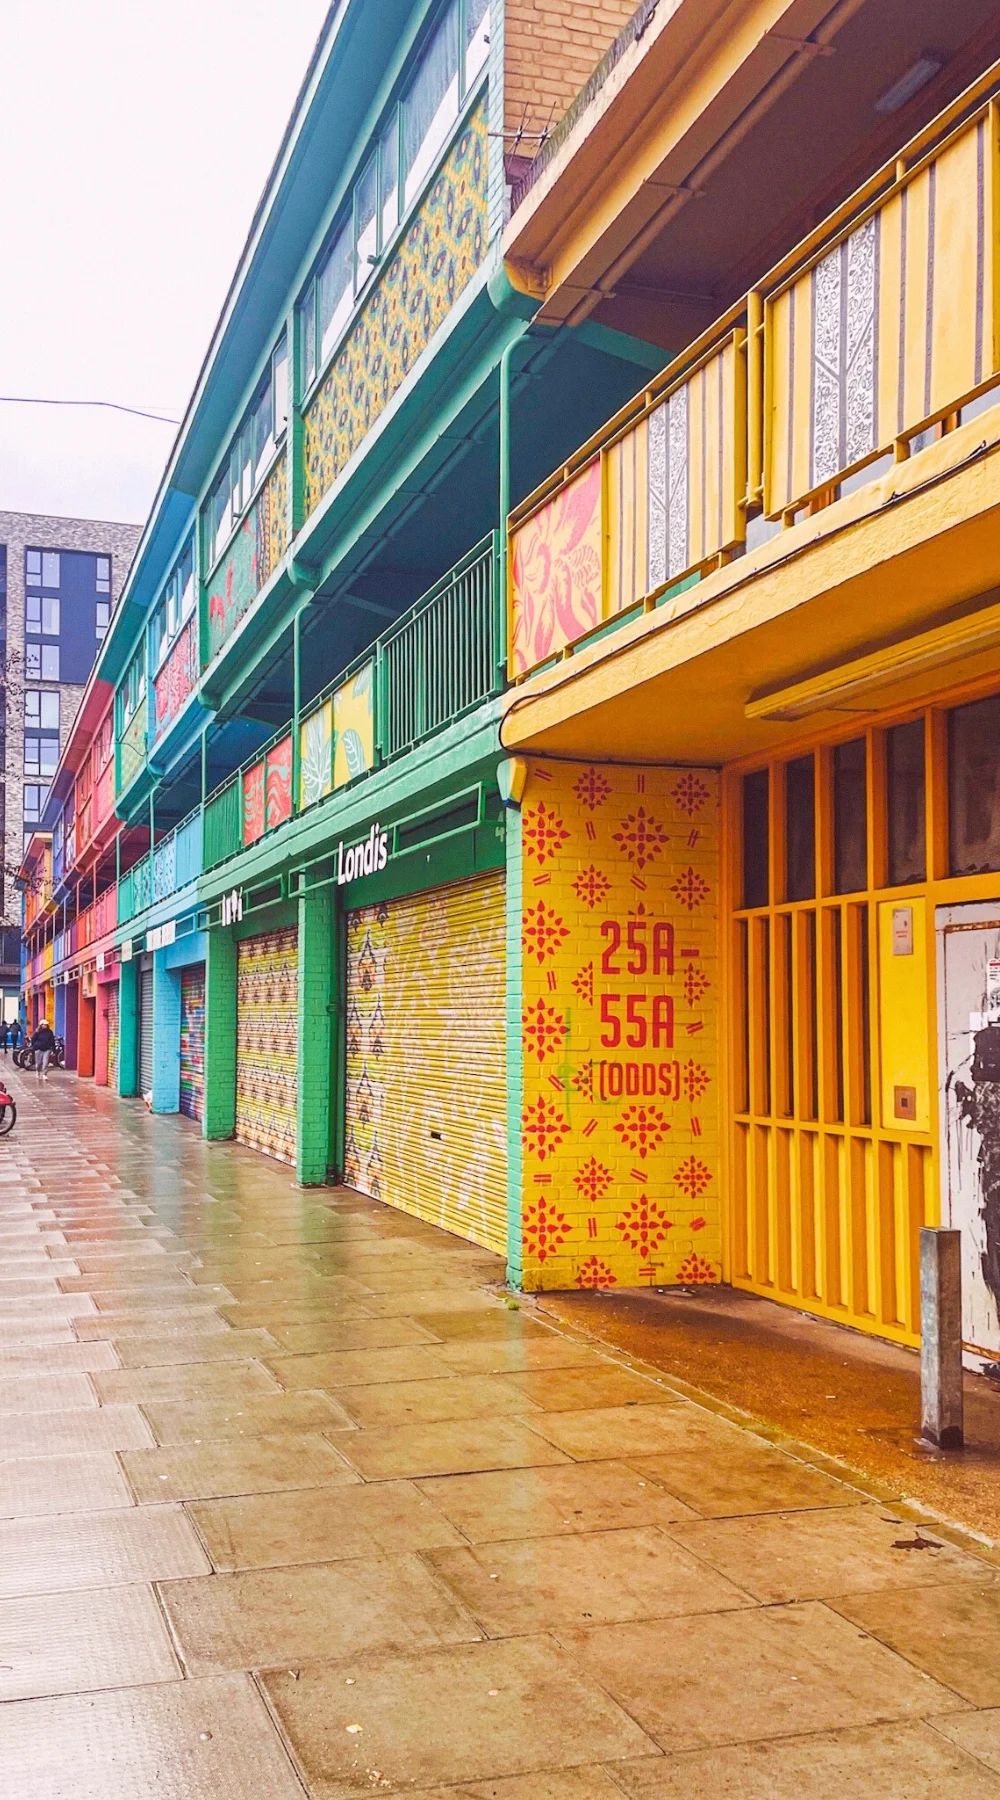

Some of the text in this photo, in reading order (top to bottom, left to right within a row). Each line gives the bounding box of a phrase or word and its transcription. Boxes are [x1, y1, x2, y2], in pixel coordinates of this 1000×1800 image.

[337, 822, 388, 886] Londis
[600, 993, 675, 1049] 55A
[600, 1059, 681, 1102] (ODDS)
